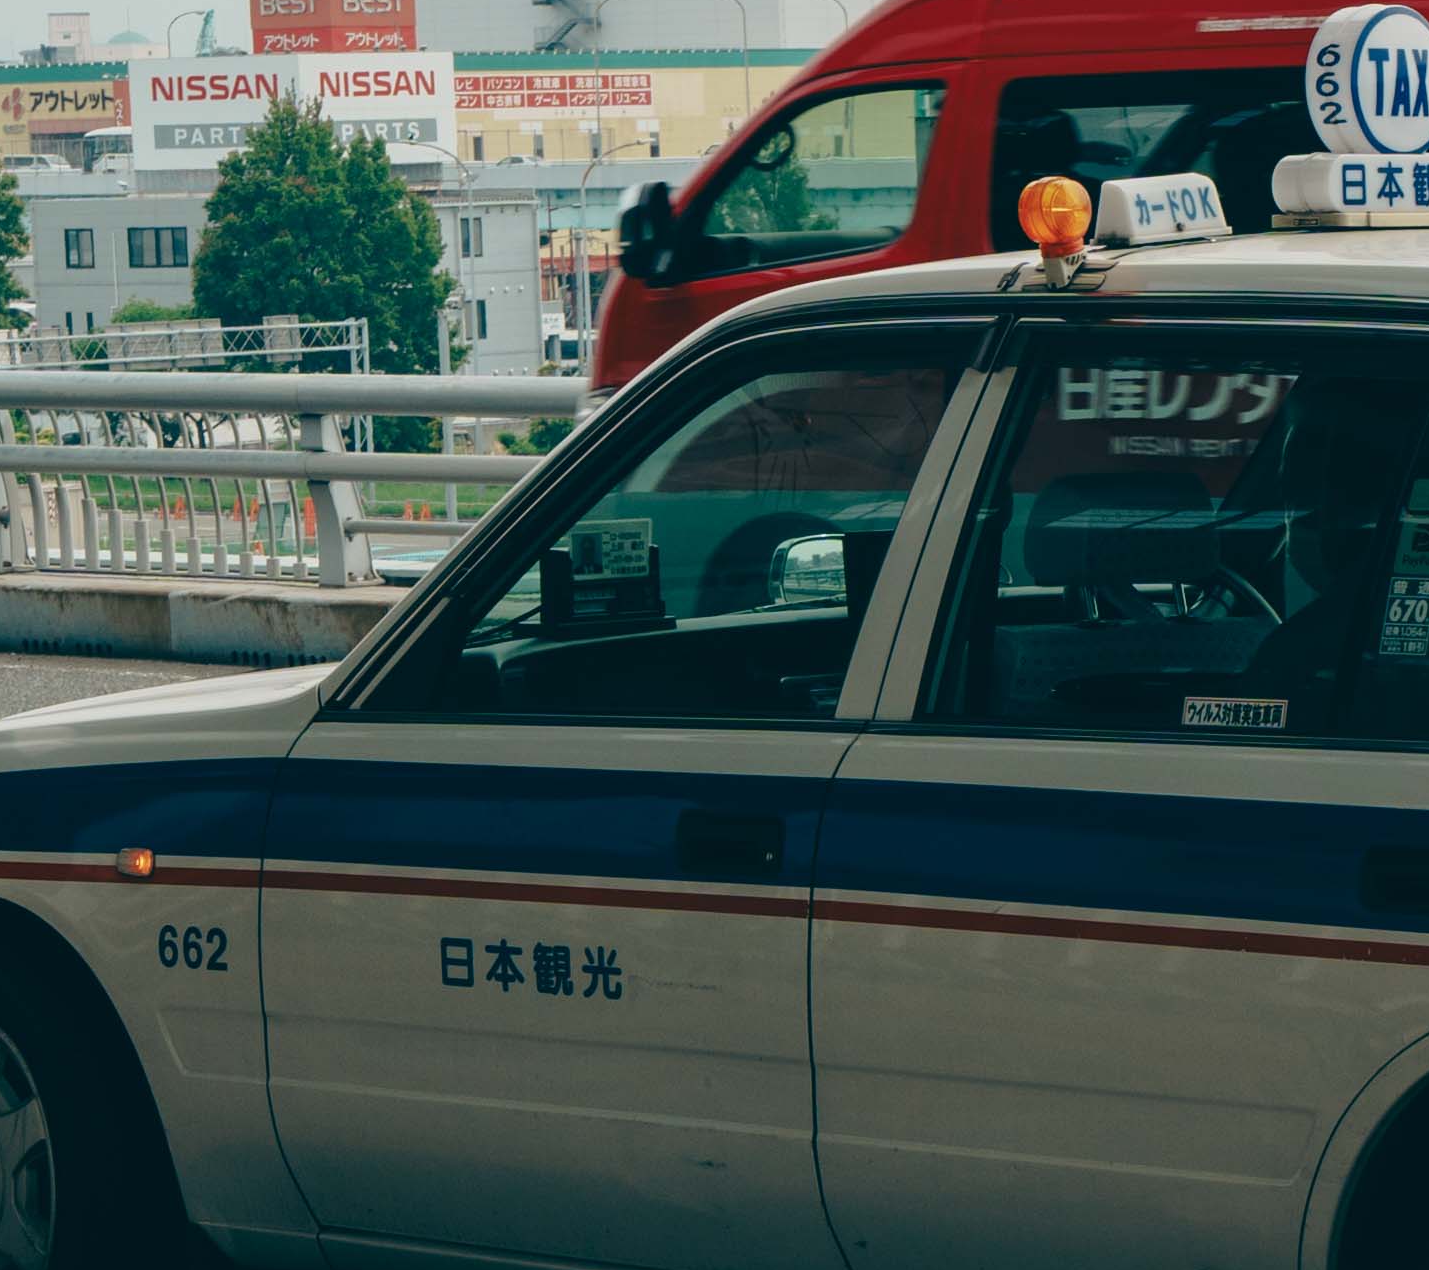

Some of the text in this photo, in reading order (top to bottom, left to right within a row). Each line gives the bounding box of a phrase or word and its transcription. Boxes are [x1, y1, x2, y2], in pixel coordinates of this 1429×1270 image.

[264, 32, 320, 50] アウトレット
[345, 31, 404, 49] アウトレット
[150, 73, 279, 102] NISSAN
[319, 70, 436, 98] NISSAN
[1315, 43, 1348, 125] 662
[29, 88, 115, 113] アウトレット
[535, 94, 560, 106] ゲーム
[173, 126, 243, 146] PART
[157, 923, 229, 972] 662
[439, 936, 623, 1000] 日本観光
